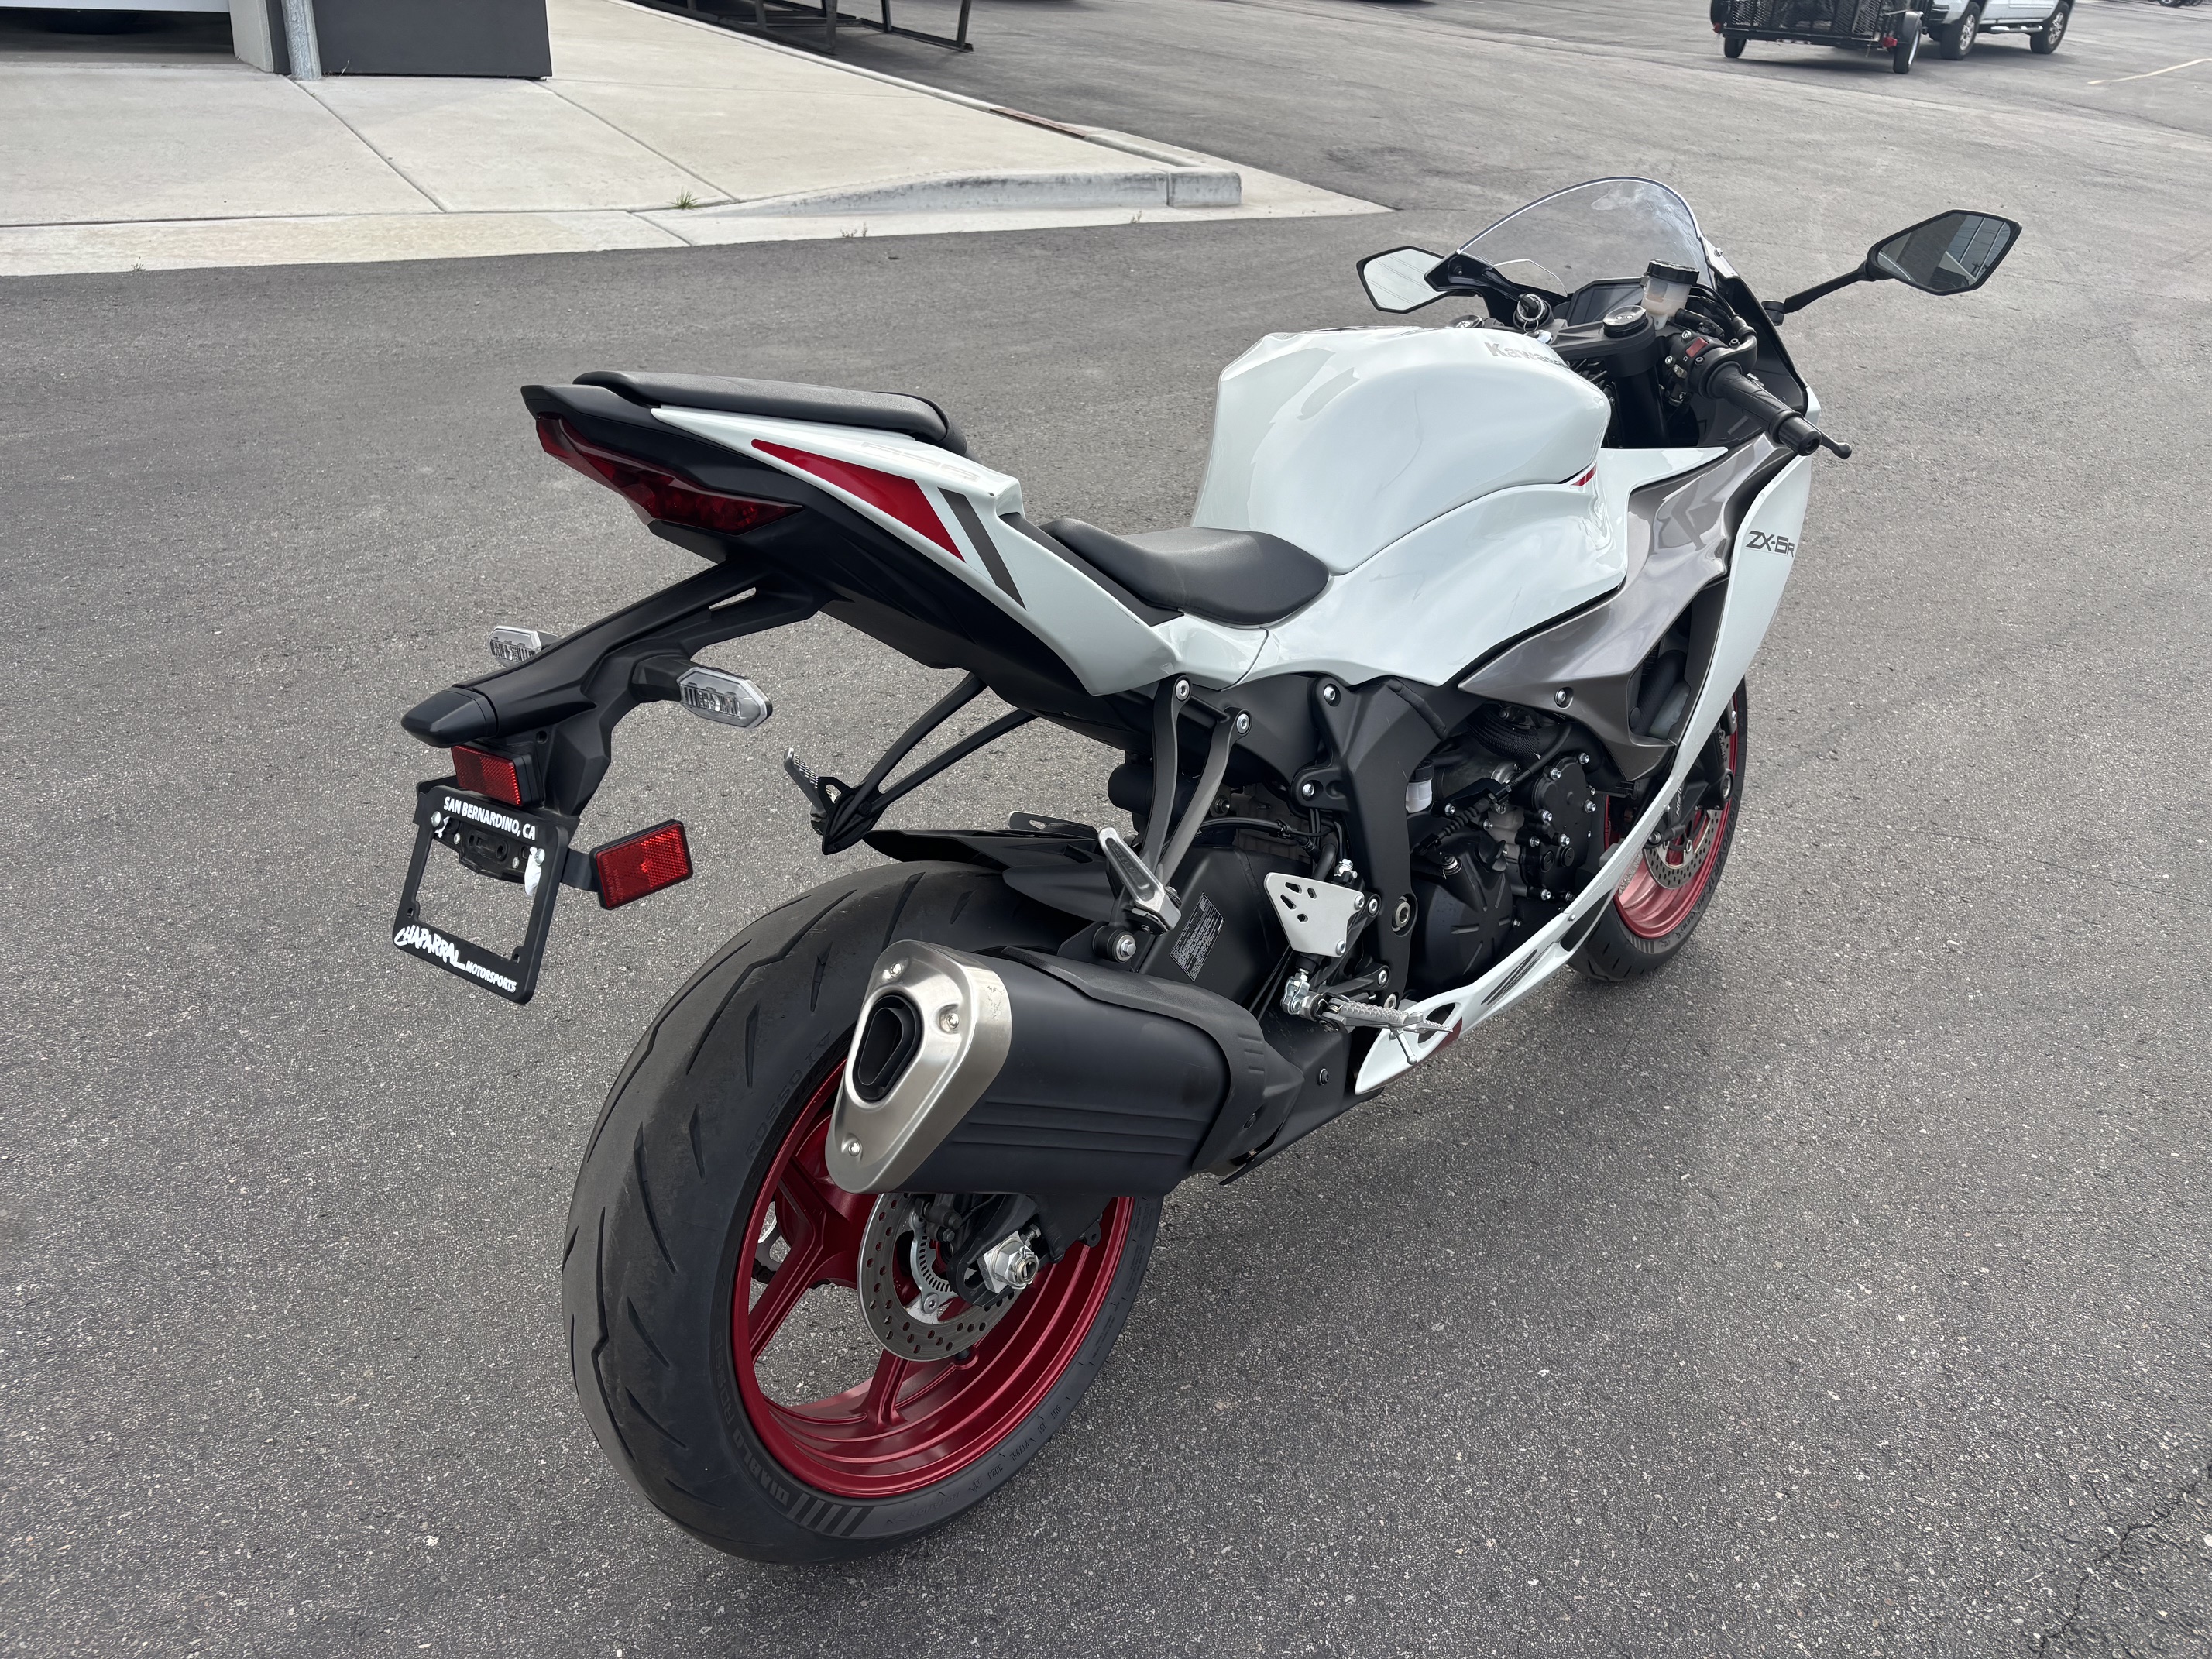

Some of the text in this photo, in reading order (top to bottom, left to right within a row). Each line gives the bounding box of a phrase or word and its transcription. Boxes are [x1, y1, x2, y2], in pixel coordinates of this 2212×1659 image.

[1746, 530, 1795, 558] ZX-6R
[443, 796, 536, 840] SAN BERNARDINO, CA
[394, 925, 466, 969] CHAPARRAL
[465, 960, 517, 994] MOTORSPORTS
[745, 1069, 803, 1160] ROSSO
[713, 1331, 790, 1506] DIABLO ROSSO
